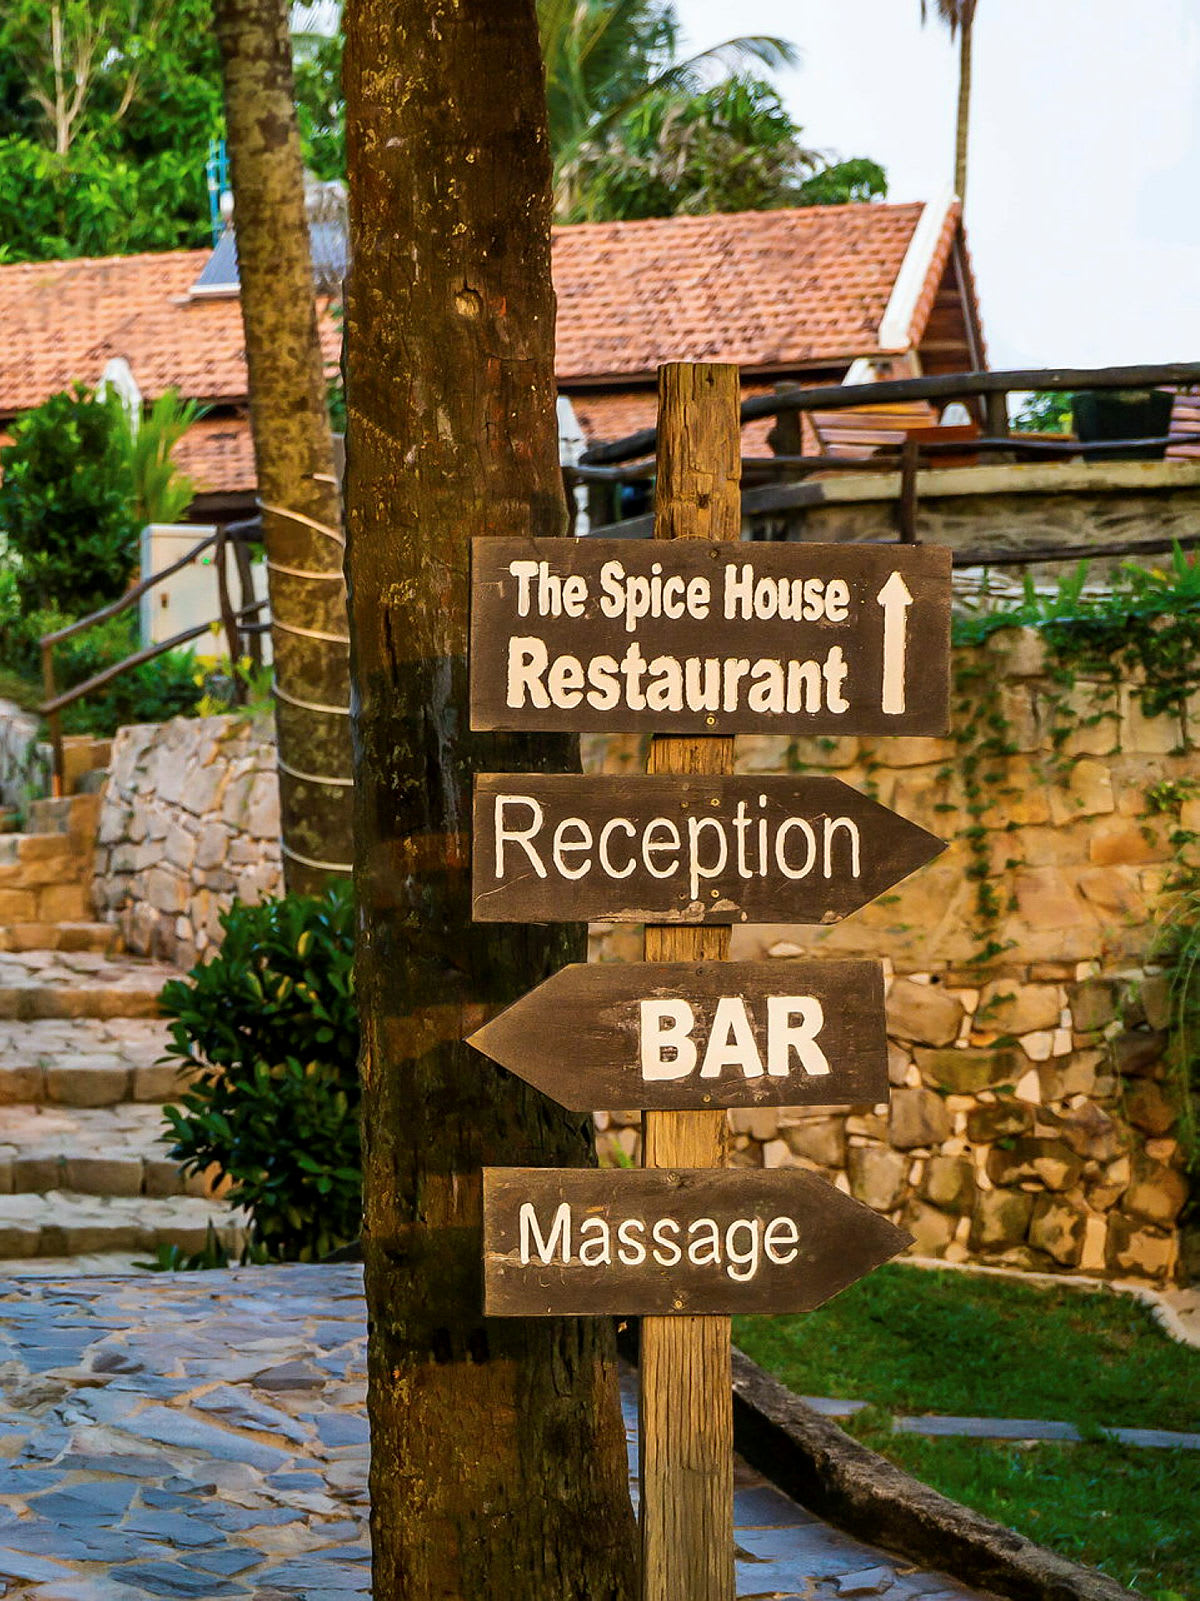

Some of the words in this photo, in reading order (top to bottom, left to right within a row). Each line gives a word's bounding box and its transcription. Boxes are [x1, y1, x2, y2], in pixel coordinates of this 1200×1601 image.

[509, 560, 589, 618] The
[600, 560, 711, 632] Spice
[724, 563, 851, 623] House
[506, 636, 851, 714] Restaurant
[494, 794, 862, 900] Reception
[640, 996, 831, 1081] BAR
[519, 1202, 800, 1282] Massage
